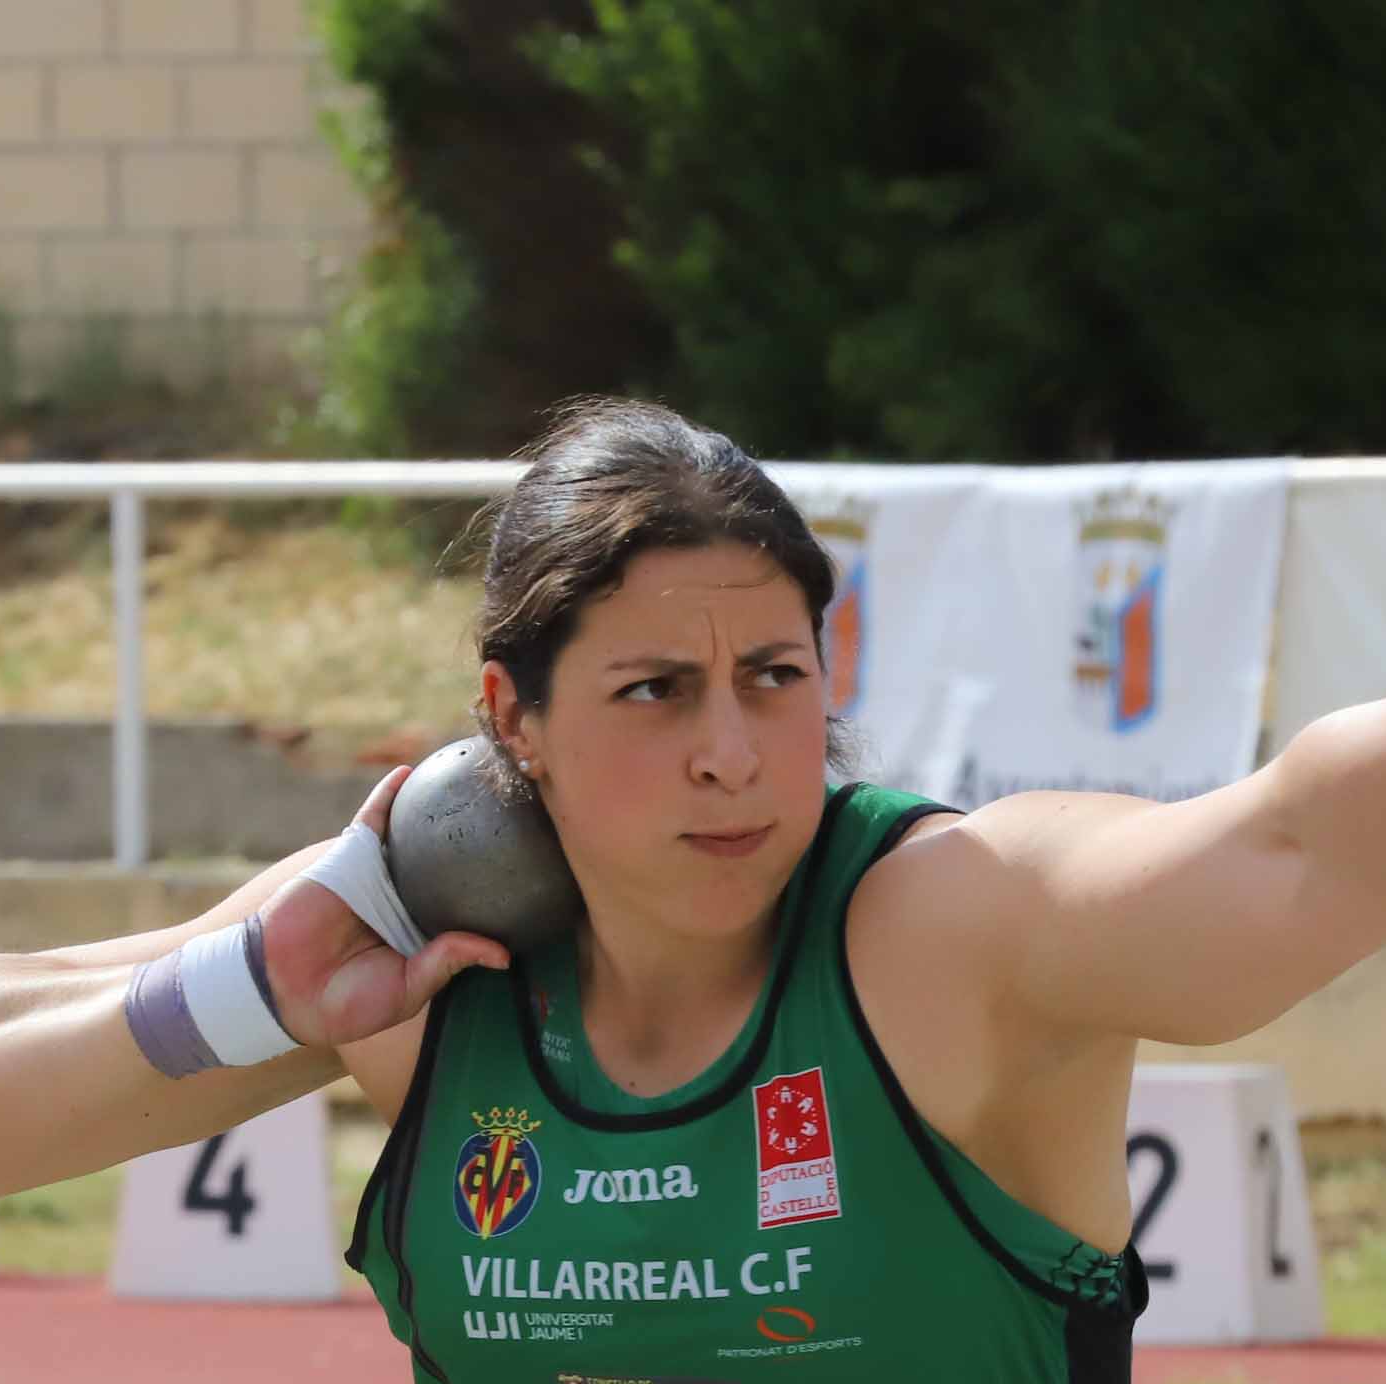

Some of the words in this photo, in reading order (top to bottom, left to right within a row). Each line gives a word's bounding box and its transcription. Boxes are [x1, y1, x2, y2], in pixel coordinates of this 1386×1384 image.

[180, 1131, 259, 1237] 4
[760, 1193, 836, 1218] CASTELLÓ
[1125, 1132, 1180, 1280] 2
[462, 1255, 729, 1301] VILLARREAL
[740, 1246, 812, 1295] C.F
[524, 1313, 613, 1327] UNIVERSITAT
[527, 1327, 576, 1340] JAUME
[717, 1346, 782, 1359] PATRONAT
